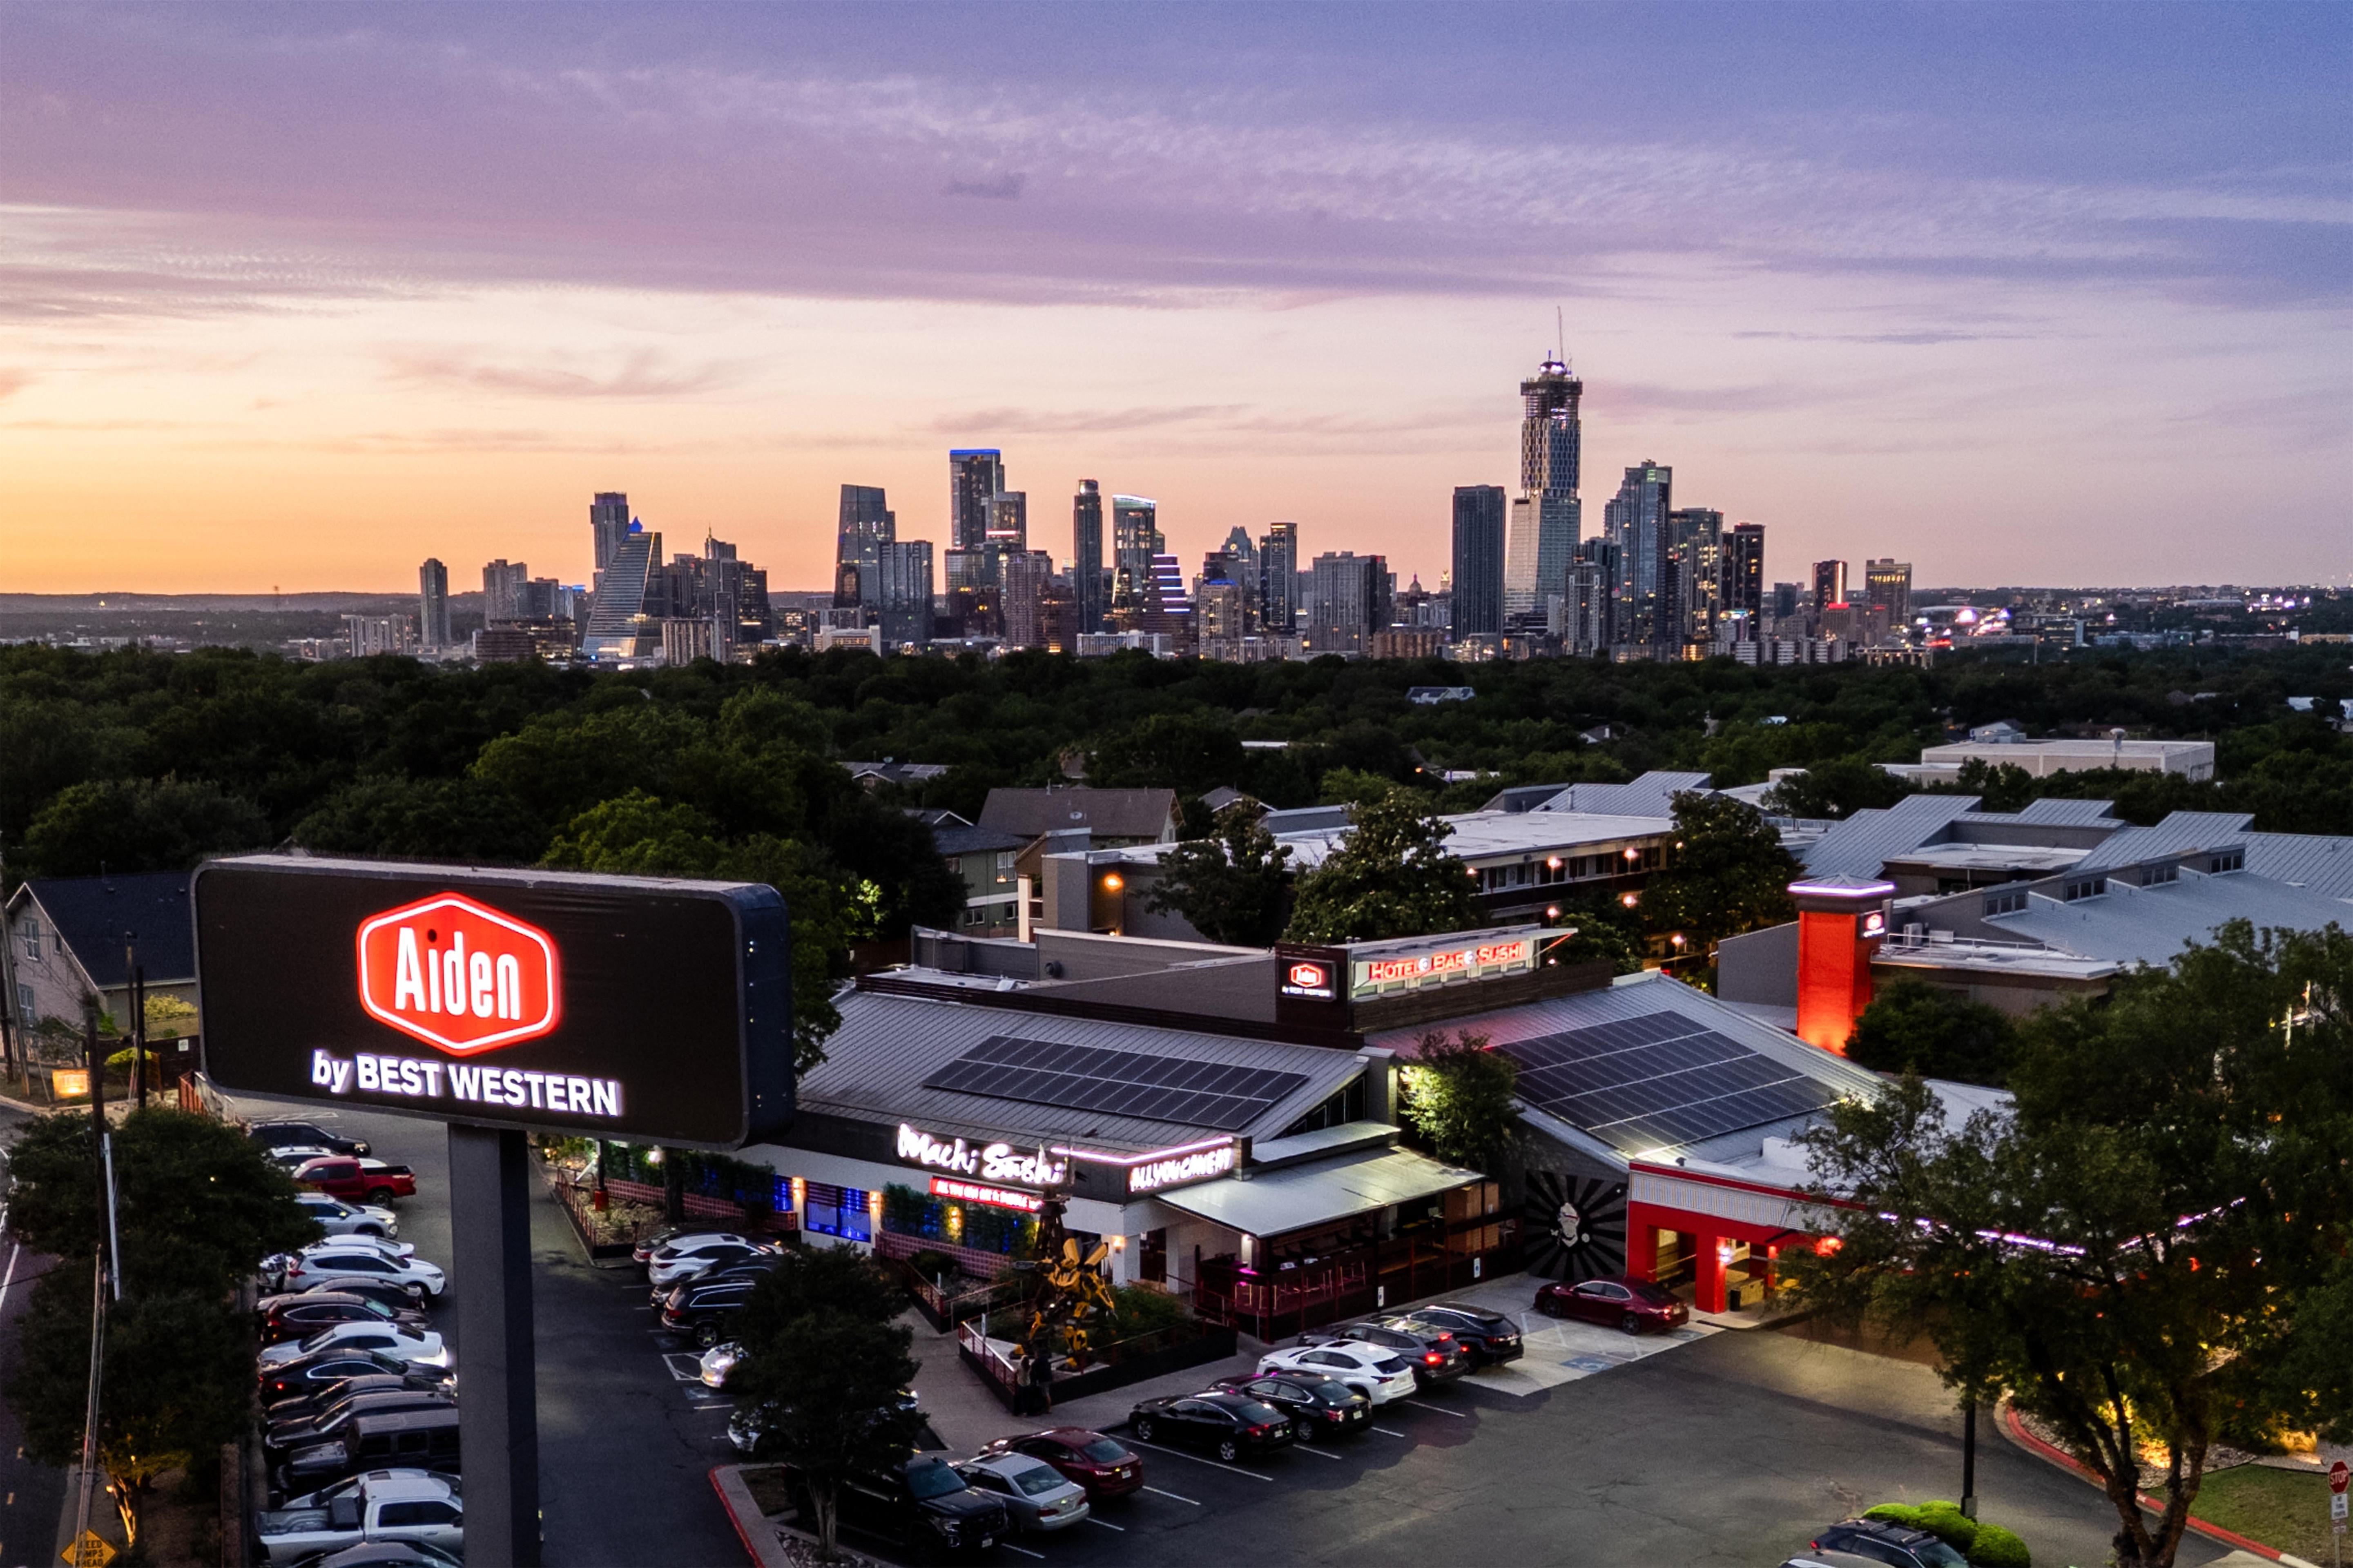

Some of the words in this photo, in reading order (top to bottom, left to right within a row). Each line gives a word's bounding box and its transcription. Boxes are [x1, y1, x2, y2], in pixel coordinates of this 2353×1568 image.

[395, 927, 520, 1020] Aiden
[1371, 961, 1419, 979] HOTEL
[1433, 953, 1464, 972] BAR
[1478, 942, 1524, 963] SUSHI
[312, 1049, 350, 1093] by
[355, 1054, 441, 1096] BEST
[448, 1063, 619, 1116] WESTERN
[897, 1123, 979, 1175] Machi
[983, 1143, 1064, 1184] Sushi
[2330, 1470, 2347, 1485] STOP
